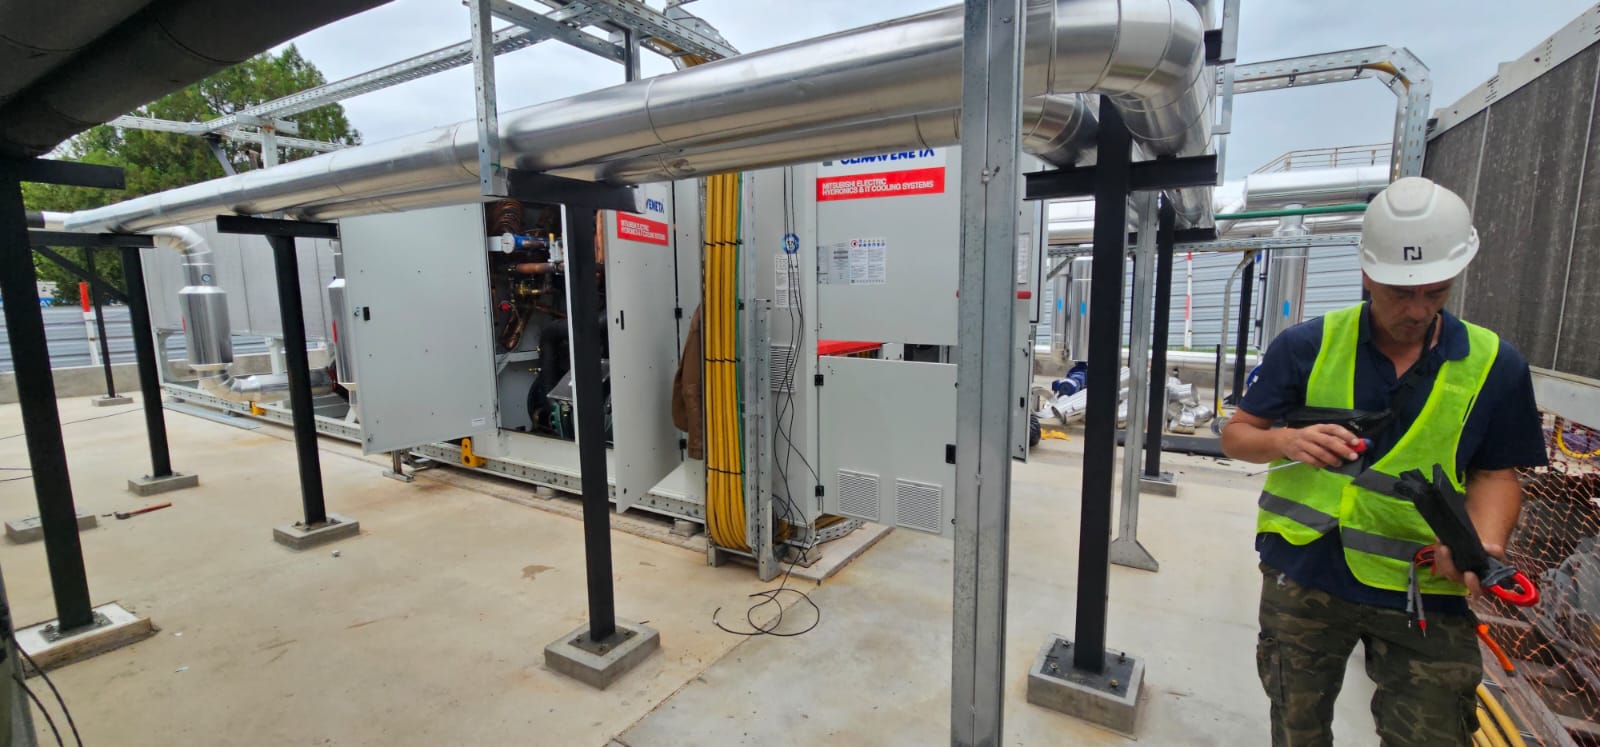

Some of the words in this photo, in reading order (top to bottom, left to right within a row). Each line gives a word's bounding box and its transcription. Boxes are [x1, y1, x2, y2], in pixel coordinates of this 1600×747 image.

[857, 178, 887, 187] ELECTRIC
[871, 183, 902, 192] COOLING
[902, 181, 934, 190] SYSTEMS
